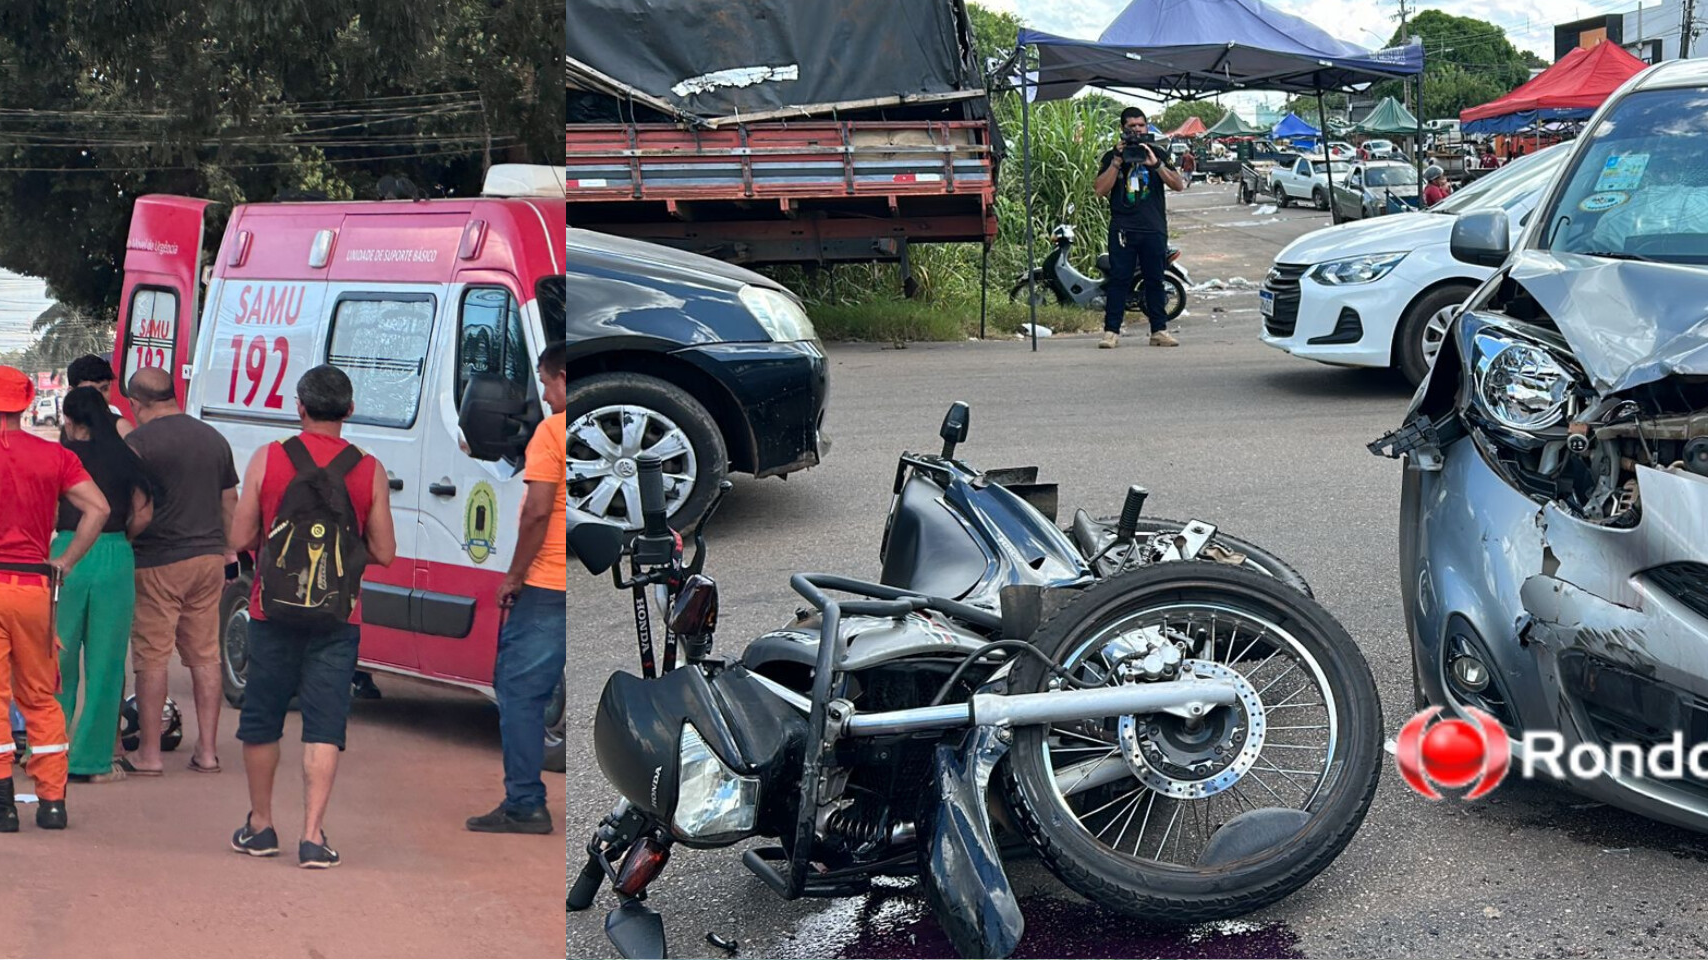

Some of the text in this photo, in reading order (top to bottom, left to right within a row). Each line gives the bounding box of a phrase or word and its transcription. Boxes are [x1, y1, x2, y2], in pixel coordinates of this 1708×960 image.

[235, 285, 306, 326] SAMU
[139, 318, 170, 339] SAMU
[228, 334, 290, 409] 192
[635, 597, 652, 655] HONDA
[651, 765, 663, 808] HONDA
